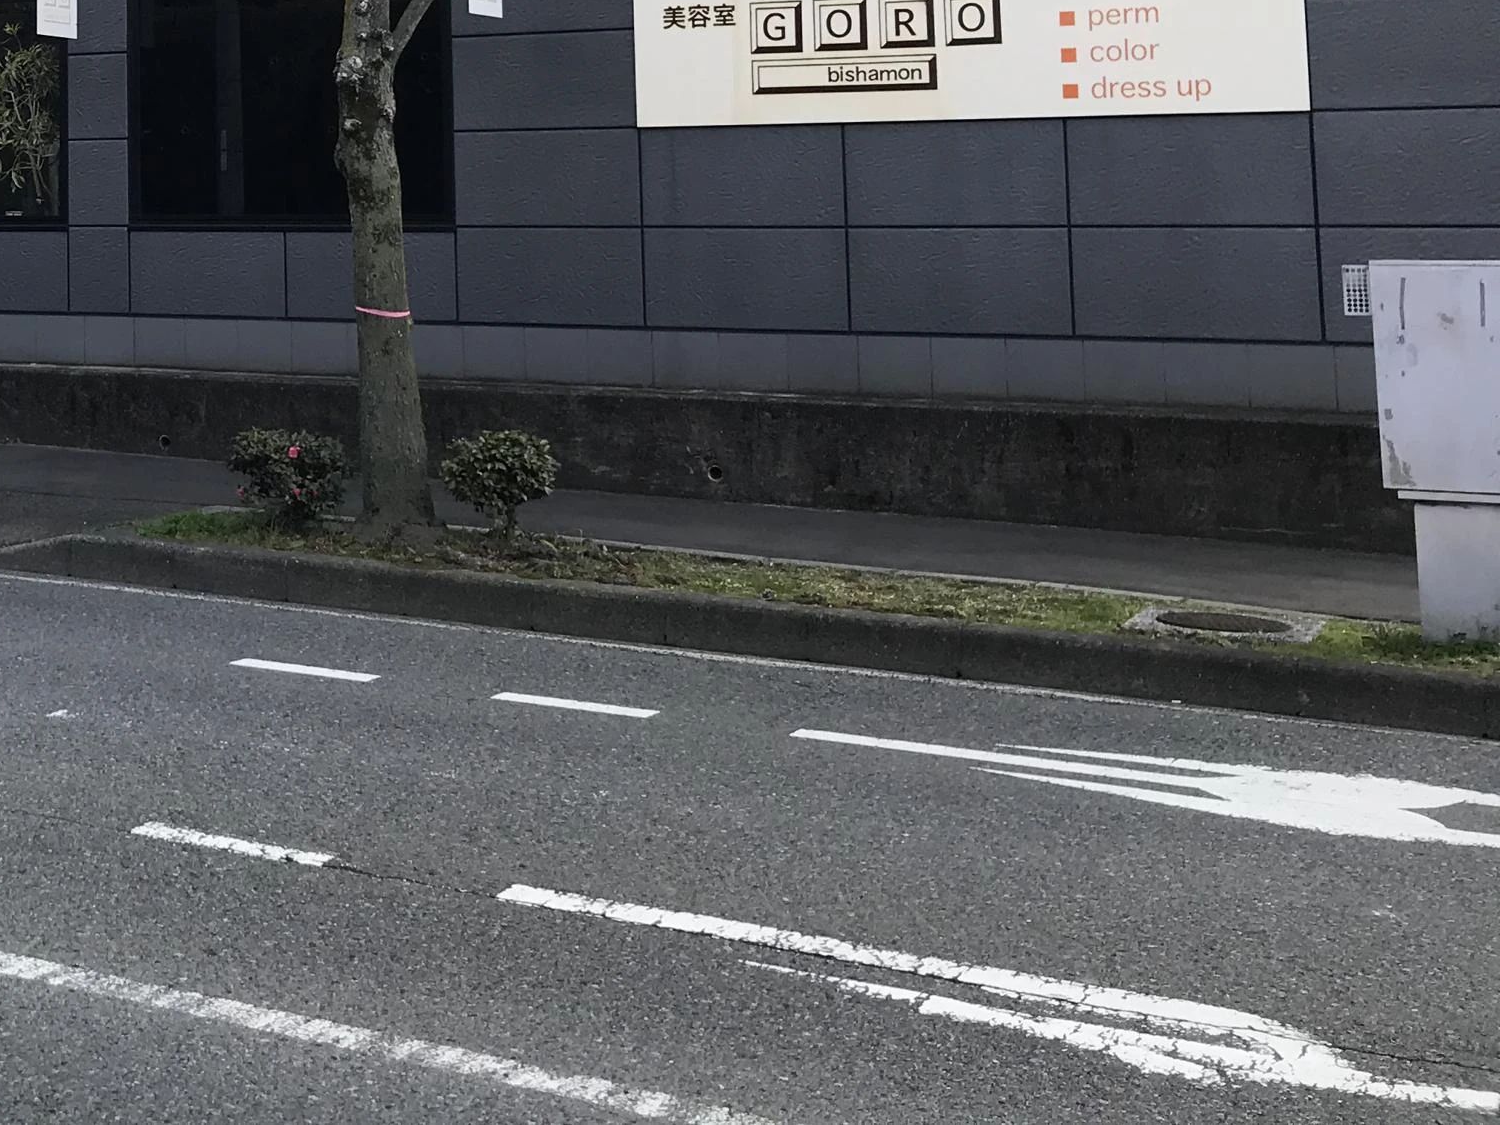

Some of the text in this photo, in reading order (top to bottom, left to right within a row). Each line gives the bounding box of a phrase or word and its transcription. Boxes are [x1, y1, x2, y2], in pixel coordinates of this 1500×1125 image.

[662, 3, 737, 29] 美容室
[762, 2, 986, 42] GORO
[1088, 6, 1160, 31] perm
[1089, 38, 1160, 63] color
[826, 64, 924, 84] bishamon
[1091, 76, 1212, 102] dress up
